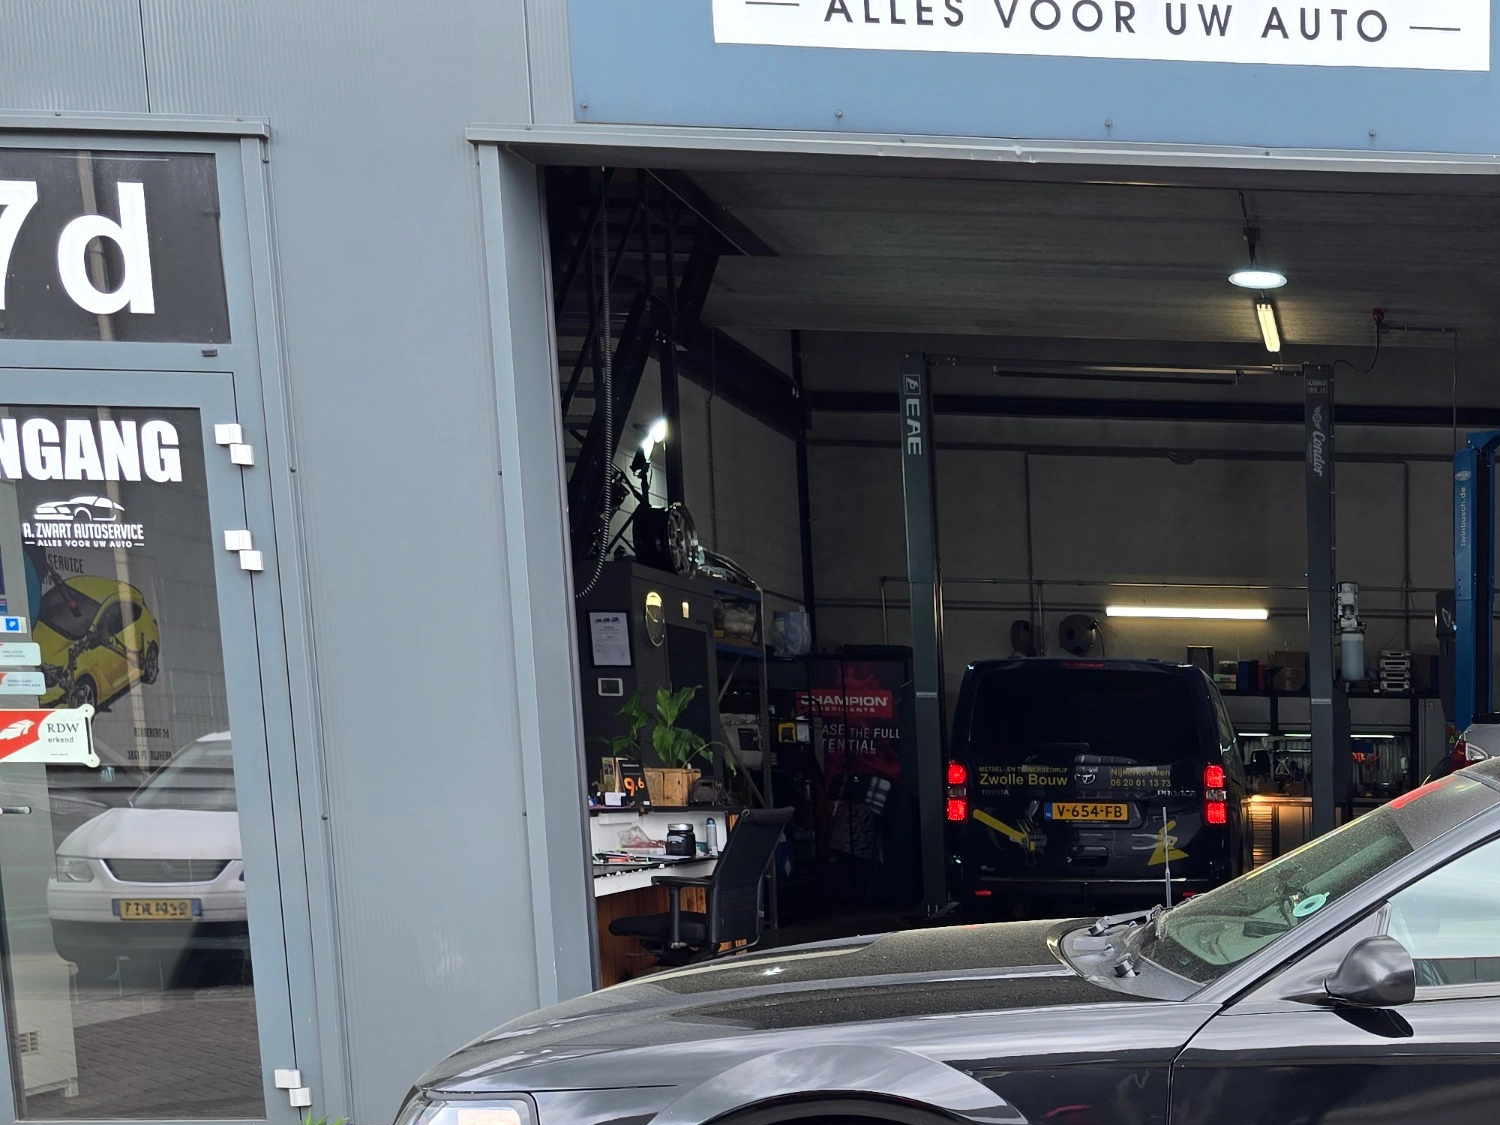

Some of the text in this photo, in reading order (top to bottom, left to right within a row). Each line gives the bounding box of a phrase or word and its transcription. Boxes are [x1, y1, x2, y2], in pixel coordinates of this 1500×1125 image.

[824, 0, 1388, 42] ALLES VOOR UW AUTO
[905, 398, 922, 455] EAE
[1313, 431, 1326, 476] Condor
[23, 523, 144, 539] A. ZWART AUTOSERVICE
[801, 695, 887, 706] CHAMPION
[47, 723, 79, 733] RDW
[850, 728, 869, 738] THE
[874, 728, 900, 739] FULL
[979, 773, 1068, 786] Zwolle Bouw
[1110, 779, 1171, 787] 06 20 01 13 73
[1056, 805, 1123, 818] V-654-FB
